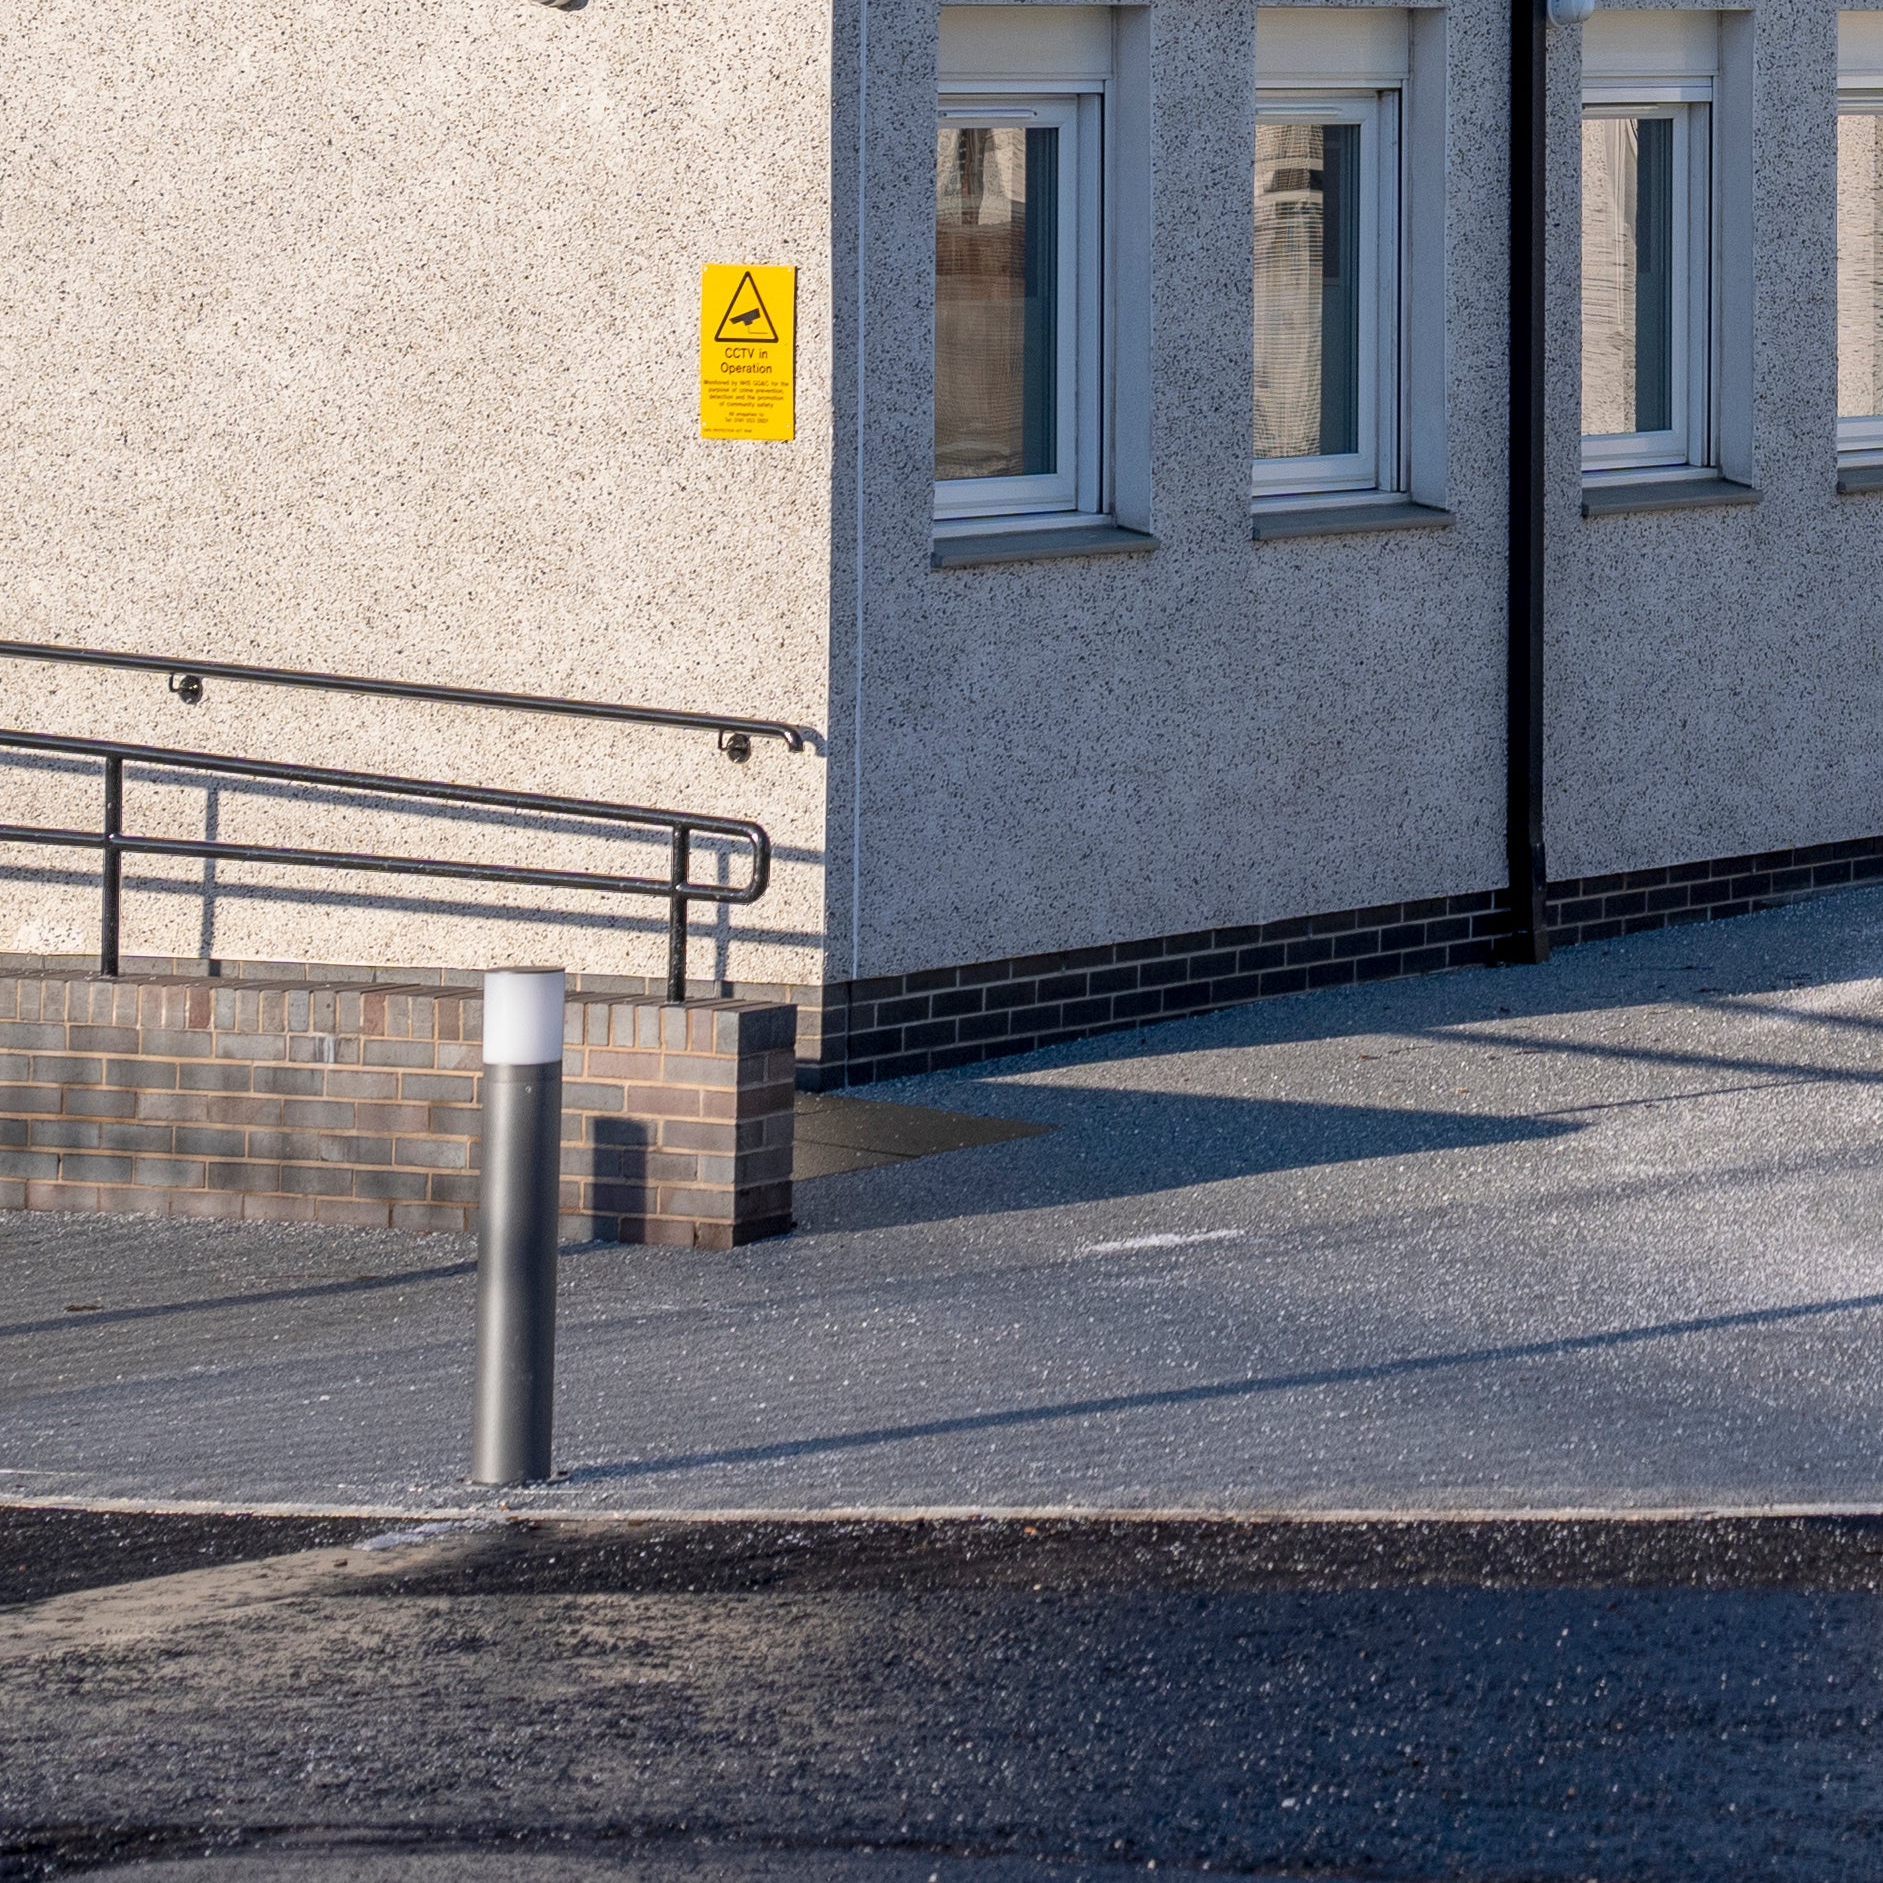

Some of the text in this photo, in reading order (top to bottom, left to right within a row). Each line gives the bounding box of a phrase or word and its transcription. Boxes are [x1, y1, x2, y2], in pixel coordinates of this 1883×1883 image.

[725, 347, 768, 358] CCTV in
[720, 362, 772, 375] Operation
